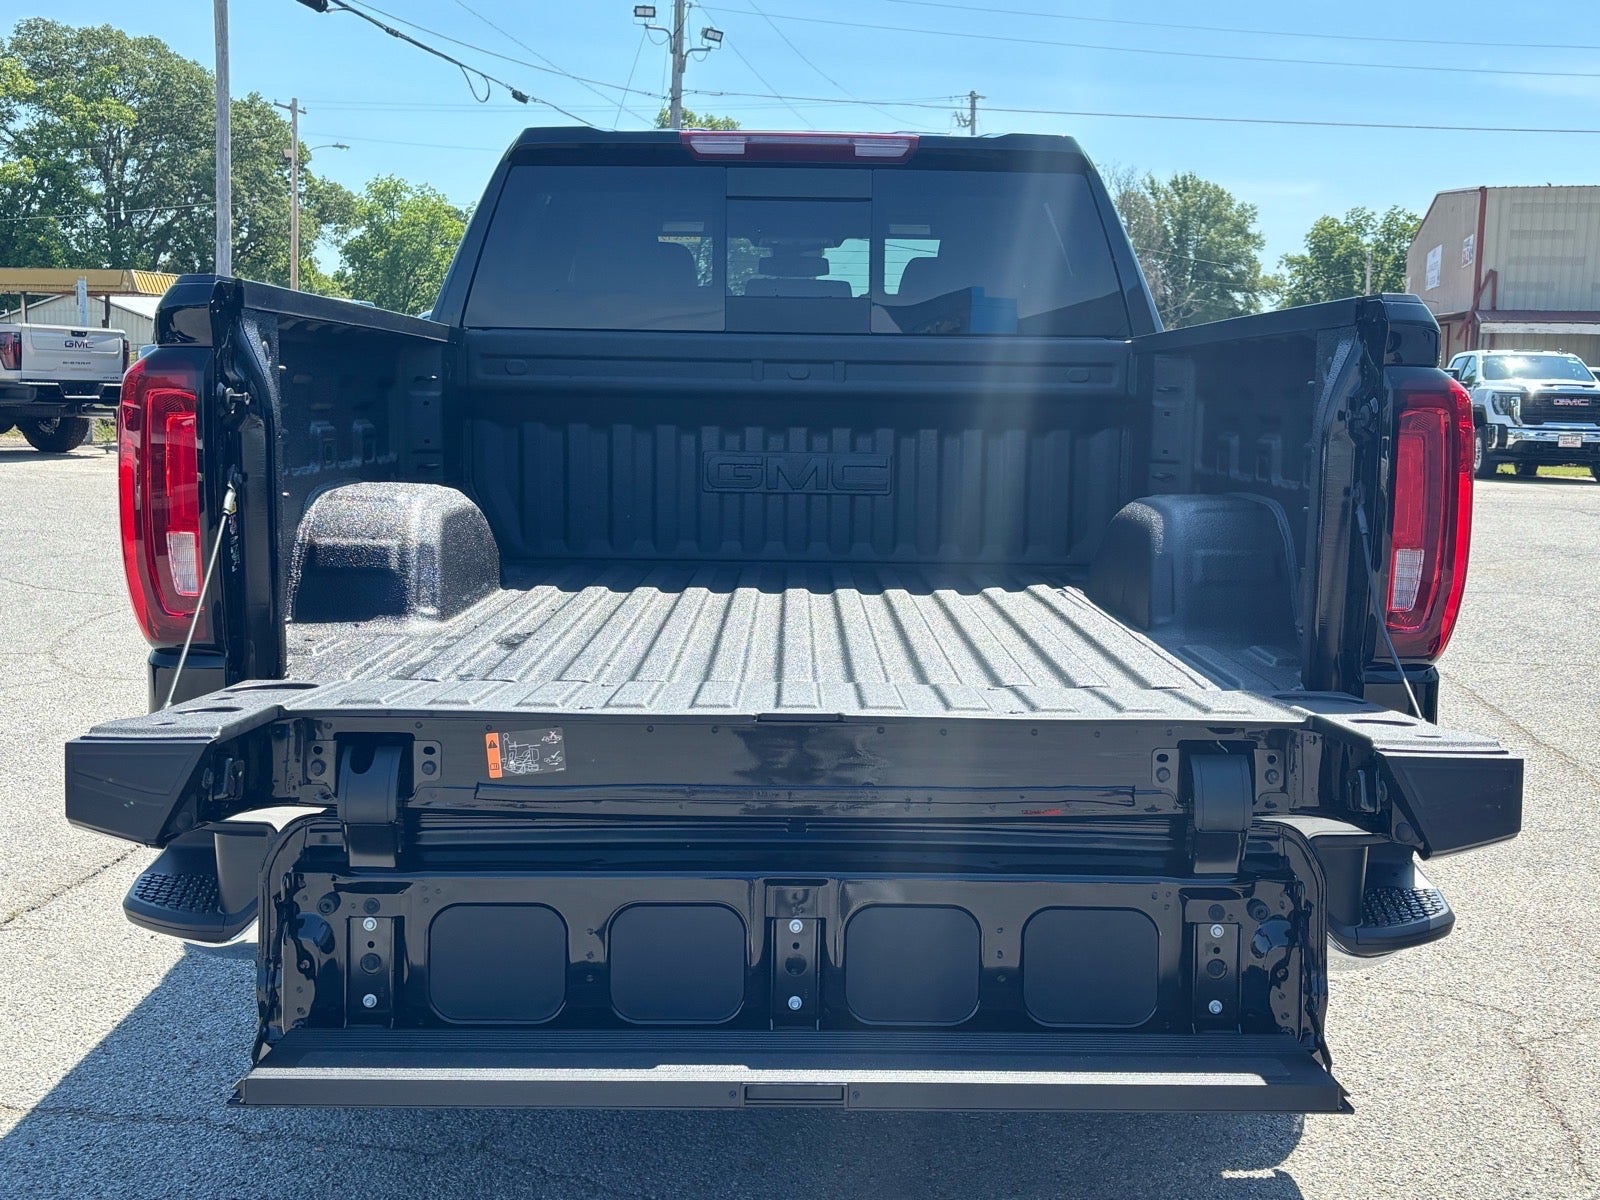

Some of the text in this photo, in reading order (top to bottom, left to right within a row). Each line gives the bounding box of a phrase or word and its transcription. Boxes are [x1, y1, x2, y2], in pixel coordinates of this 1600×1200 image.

[64, 340, 95, 349] GMC
[1553, 398, 1590, 406] GMC
[706, 455, 889, 491] GMC
